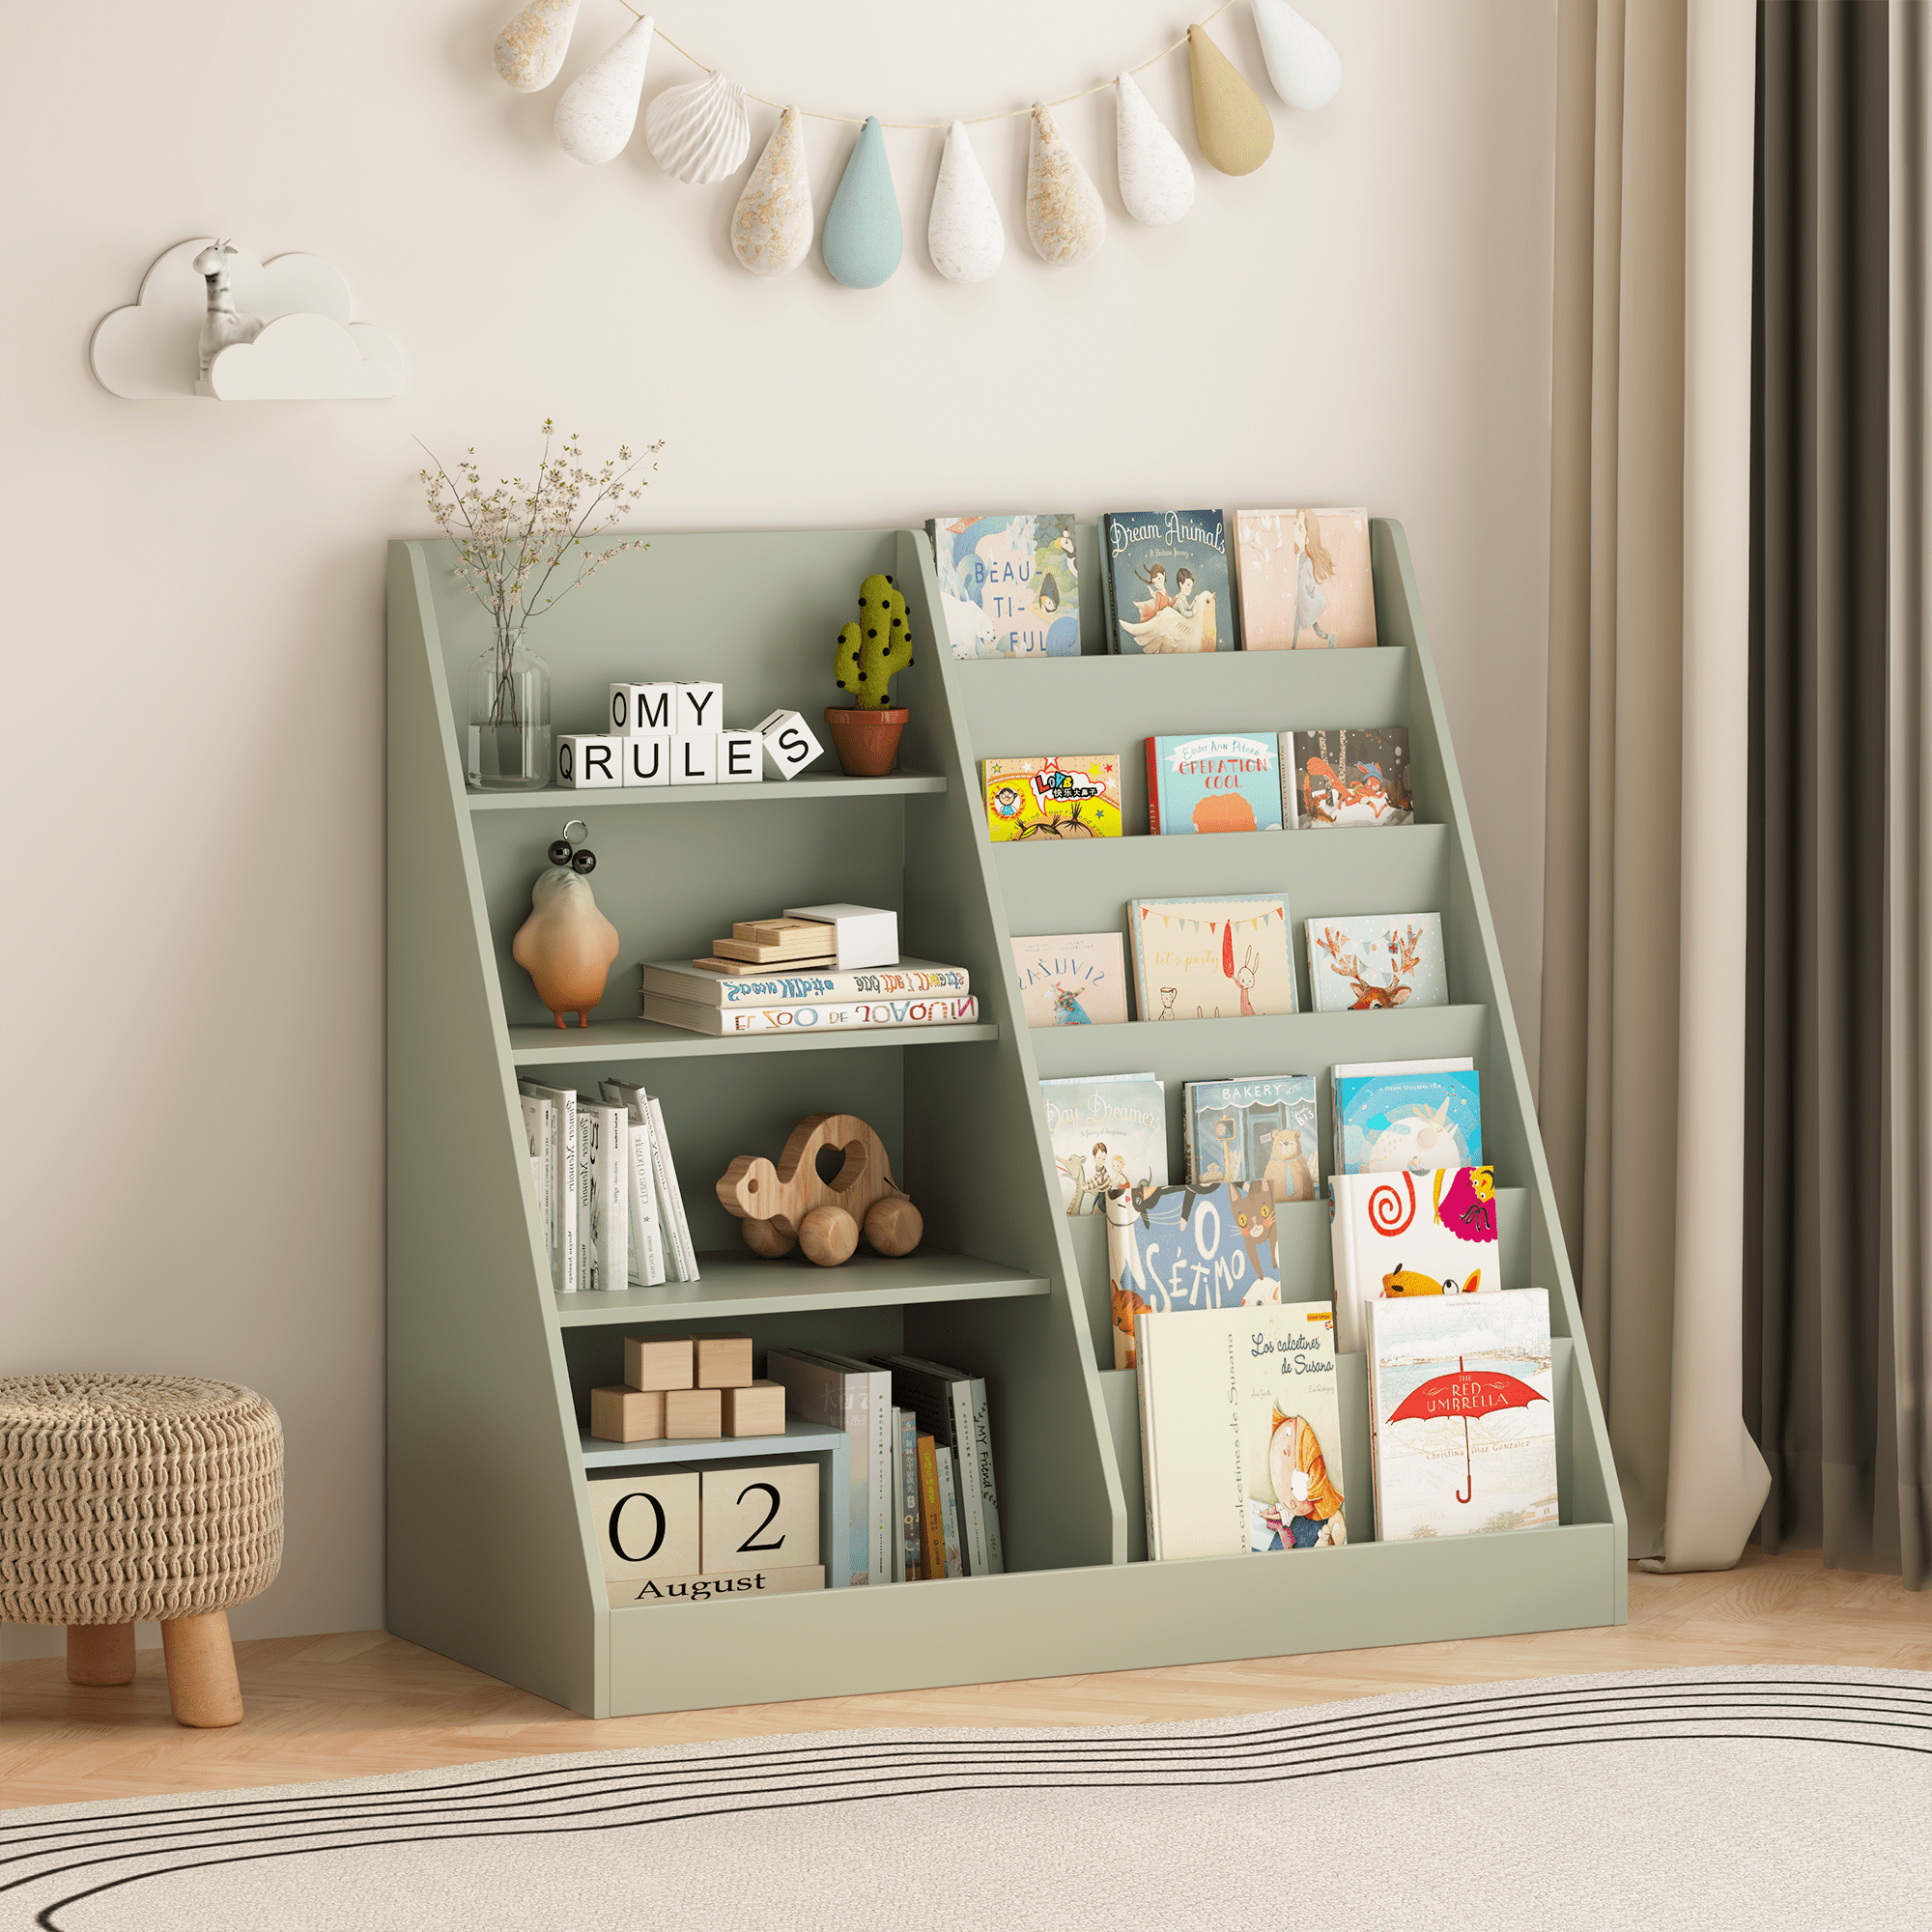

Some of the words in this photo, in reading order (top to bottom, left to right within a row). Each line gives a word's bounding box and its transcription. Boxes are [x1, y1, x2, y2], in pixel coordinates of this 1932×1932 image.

[1110, 518, 1162, 558] Dream
[1165, 510, 1225, 554] Animals
[1010, 630, 1047, 652] FUL
[638, 691, 714, 728] MY
[585, 727, 810, 781] RULES
[1179, 757, 1267, 776] OPERATION
[1205, 775, 1243, 789] COOL
[1222, 1083, 1283, 1100] BAKERY
[1085, 1090, 1161, 1132] Dreamers
[1251, 1332, 1274, 1357] Los
[1277, 1332, 1321, 1352] calcetines
[1228, 1333, 1238, 1406] Susana
[1281, 1357, 1293, 1375] de
[1293, 1354, 1334, 1376] Susana
[1459, 1374, 1472, 1382] THE
[1452, 1382, 1482, 1397] RED
[1427, 1393, 1509, 1412] UMBRELLA
[1229, 1412, 1238, 1434] de
[977, 1425, 987, 1445] MY
[980, 1451, 993, 1490] Friend
[1234, 1439, 1245, 1529] calcetines
[635, 1573, 766, 1601] August
